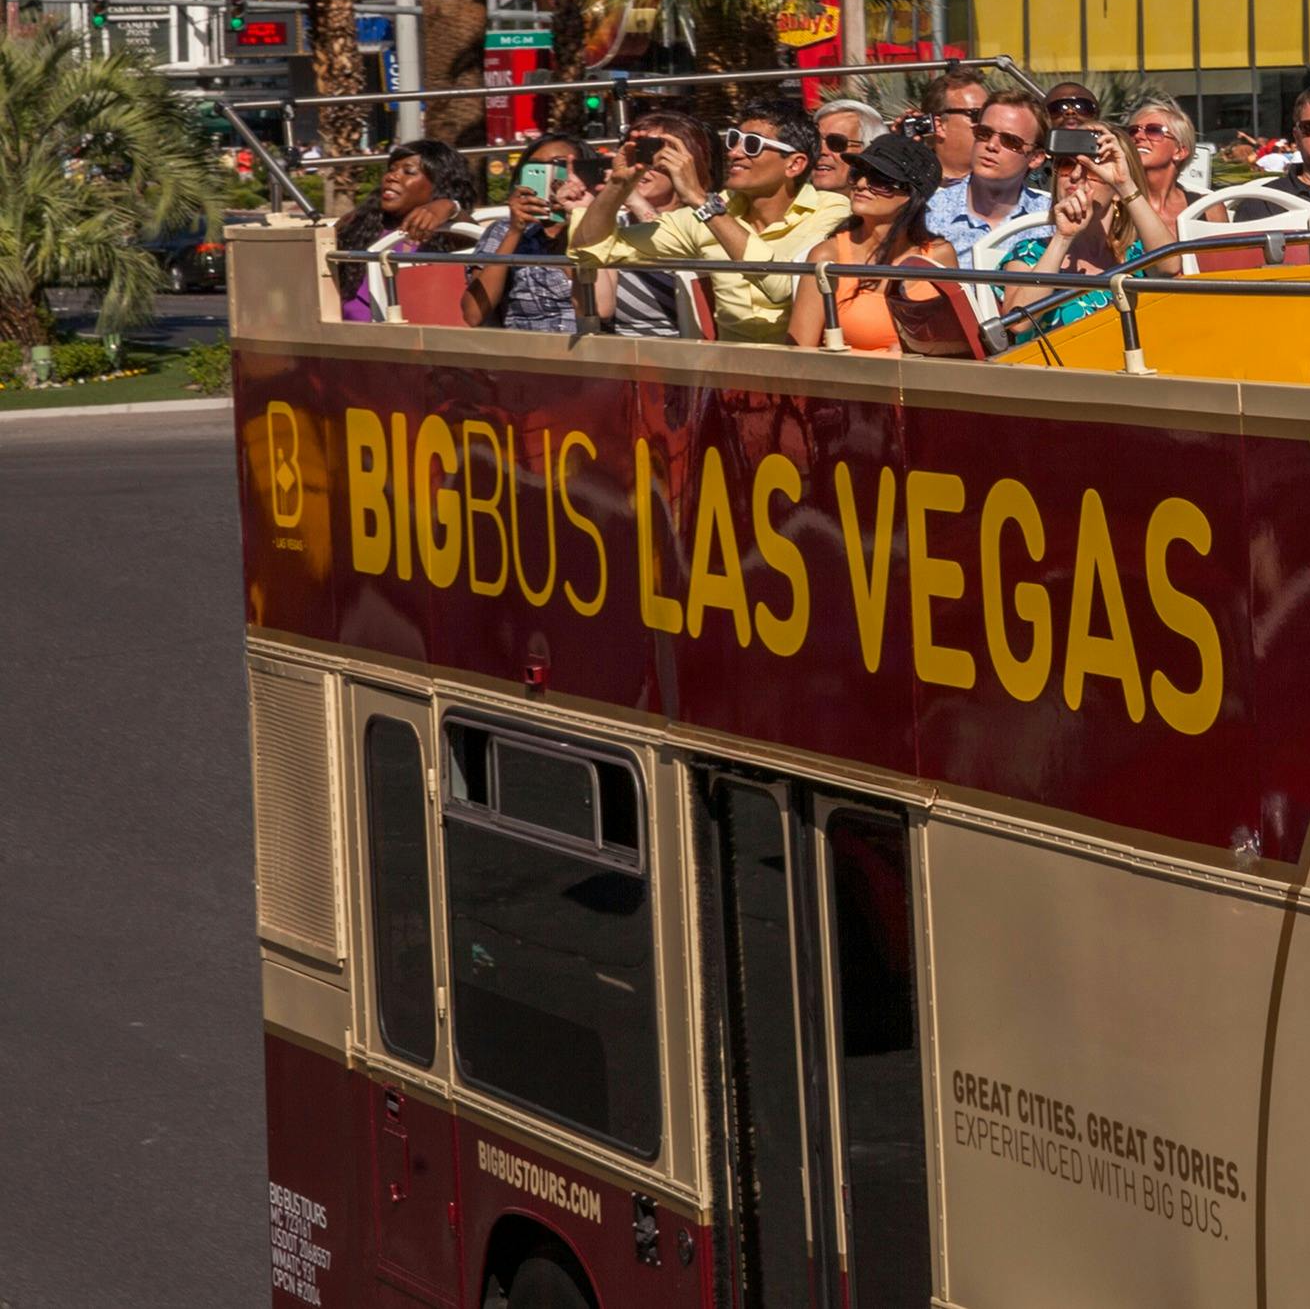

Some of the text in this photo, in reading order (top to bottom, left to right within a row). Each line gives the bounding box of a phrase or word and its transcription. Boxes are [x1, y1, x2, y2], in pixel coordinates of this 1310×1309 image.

[634, 437, 810, 658] LAS
[834, 460, 1224, 736] VEGAS
[477, 1139, 602, 1225] BIGBUSTOURS.COM
[953, 1069, 1247, 1203] GREAT CITIES. GREAT STORIES.
[954, 1110, 1229, 1242] EXPERIENCED WITH BIG BUS.
[269, 1181, 328, 1230] BIG BUS TOURS
